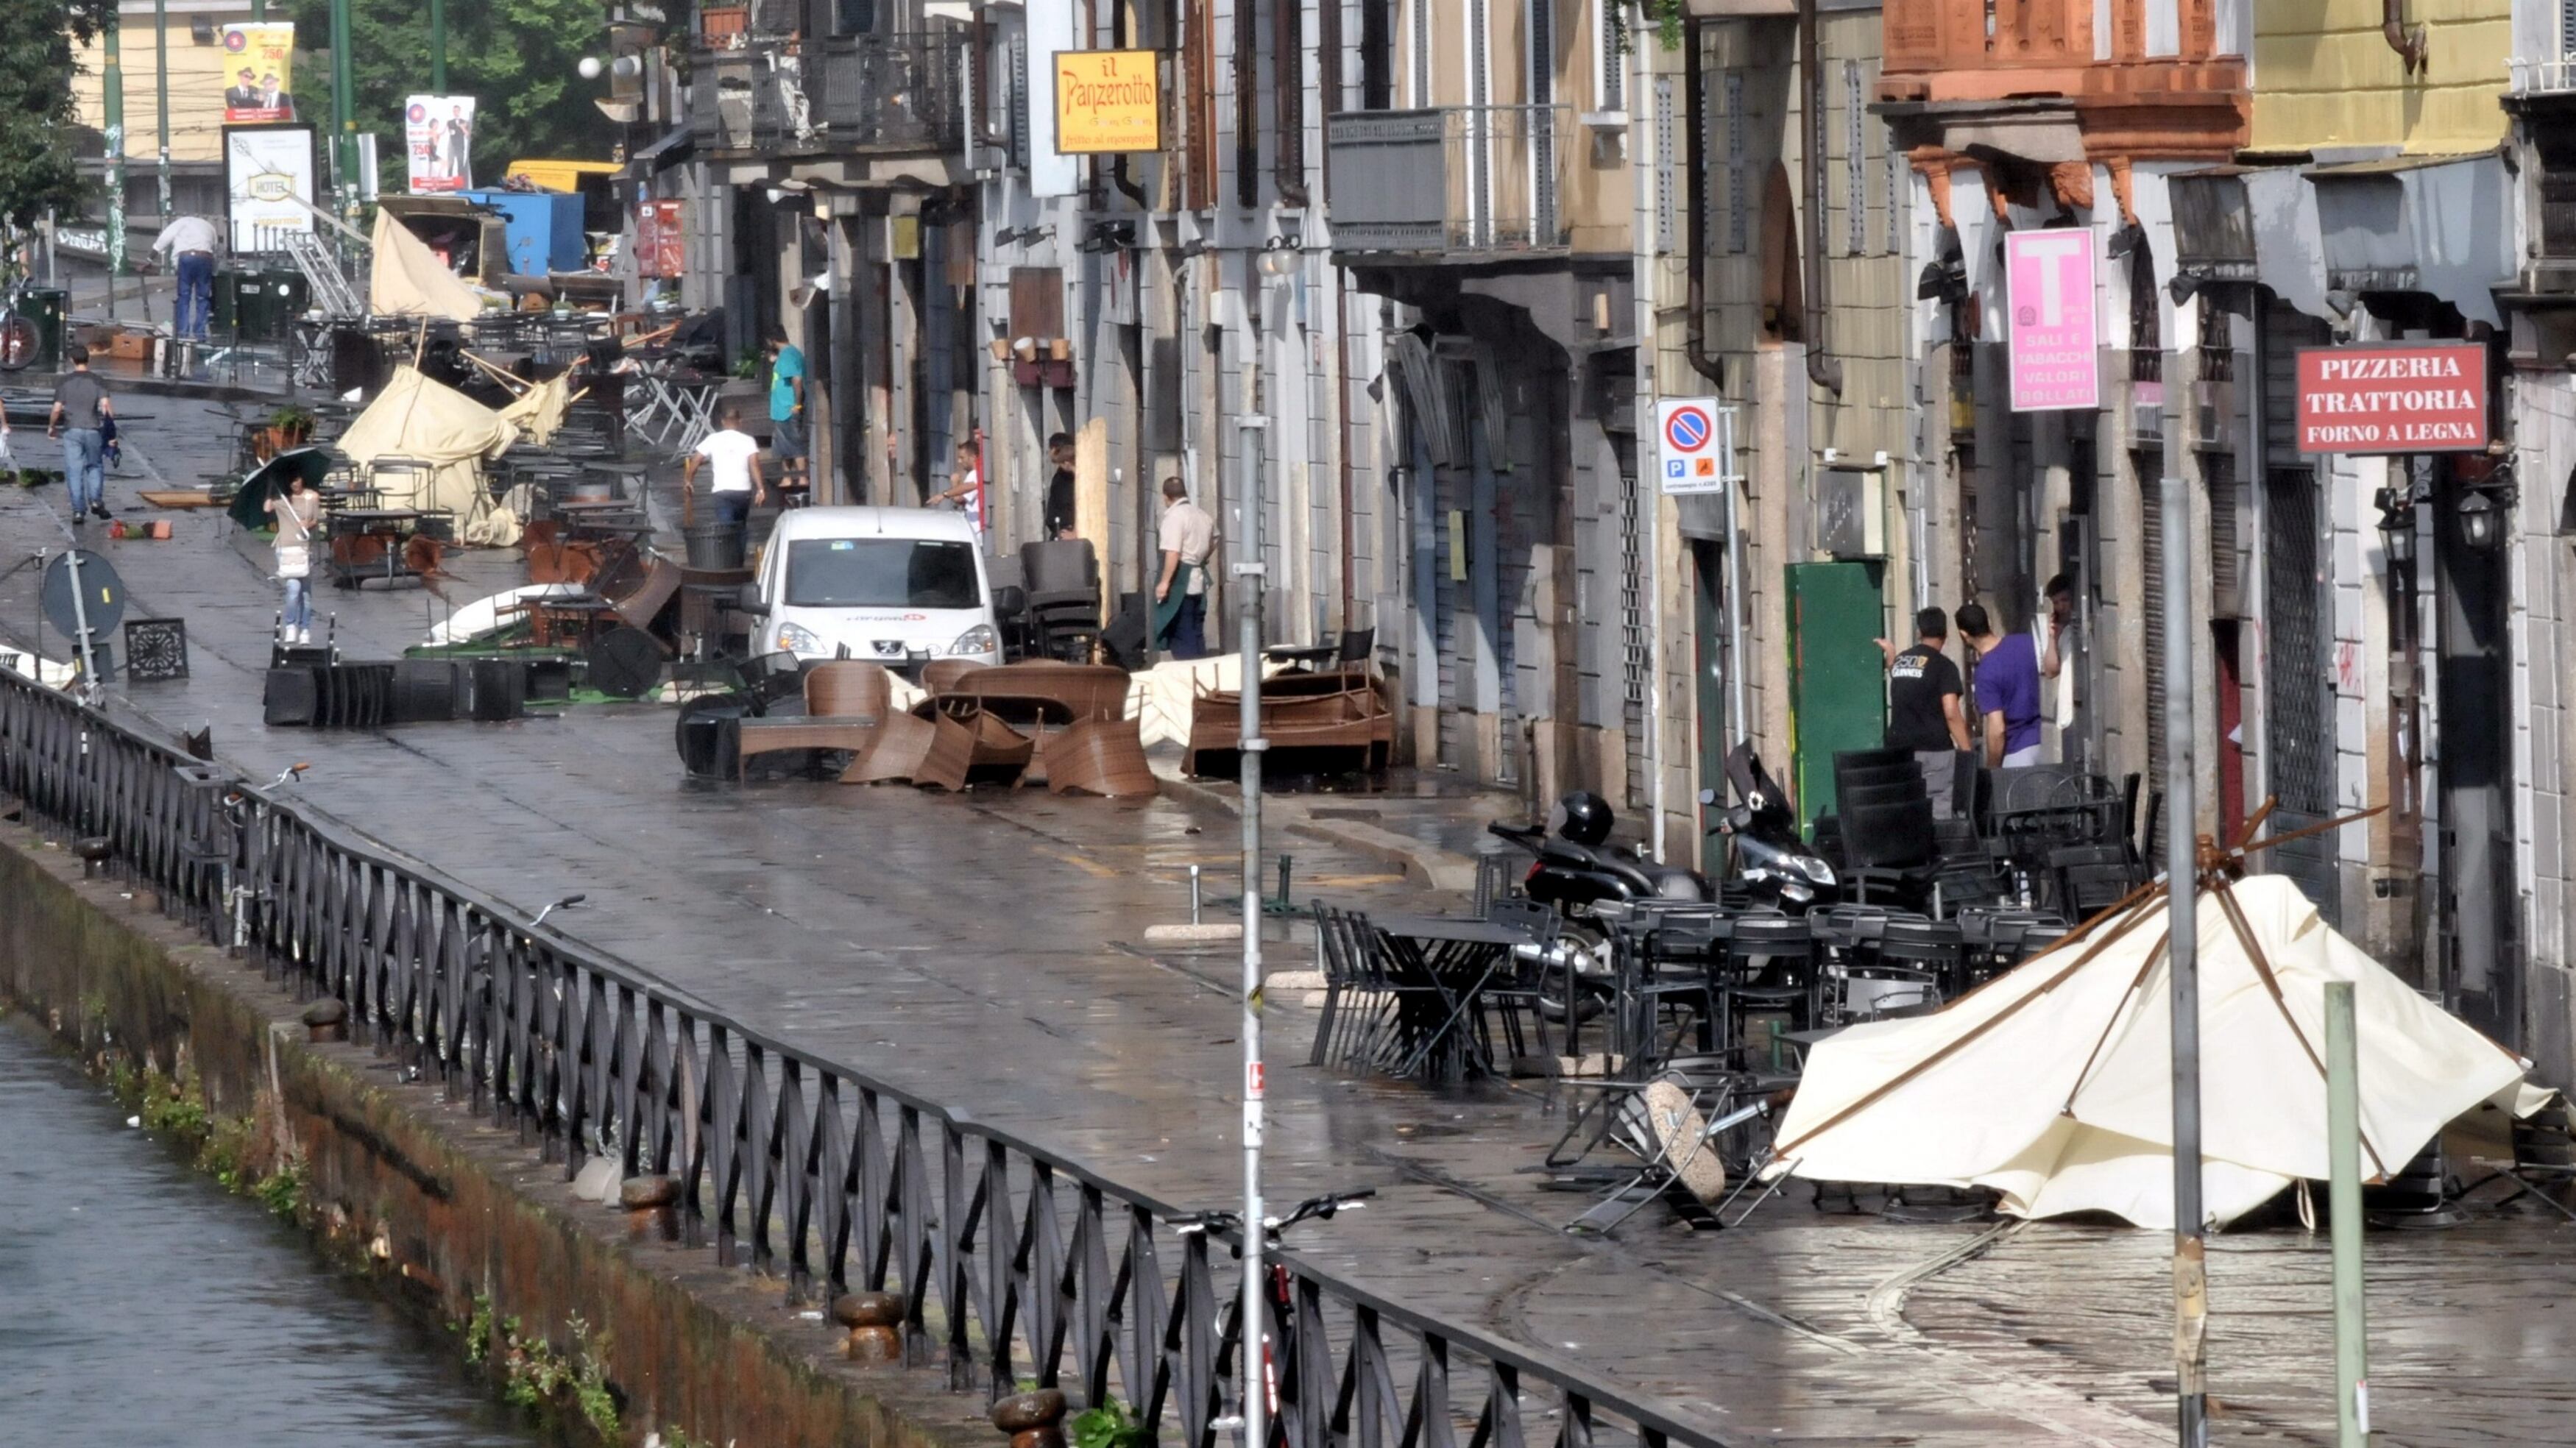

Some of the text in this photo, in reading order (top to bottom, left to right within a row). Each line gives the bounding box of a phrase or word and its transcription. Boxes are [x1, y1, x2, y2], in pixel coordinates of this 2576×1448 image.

[262, 48, 283, 60] 250
[1102, 57, 1117, 77] il
[1062, 70, 1153, 115] Panzerotto
[1094, 132, 1105, 144] al
[2017, 238, 2081, 327] T
[2025, 333, 2081, 347] SALI E
[2019, 350, 2091, 366] TABACCHI
[2023, 369, 2088, 385] VALORI
[2320, 356, 2461, 380] PIZZERIA
[2020, 388, 2090, 403] BOLLATI
[2306, 389, 2476, 414] TRATTORIA
[2307, 422, 2477, 443] FORNO A LEGNA
